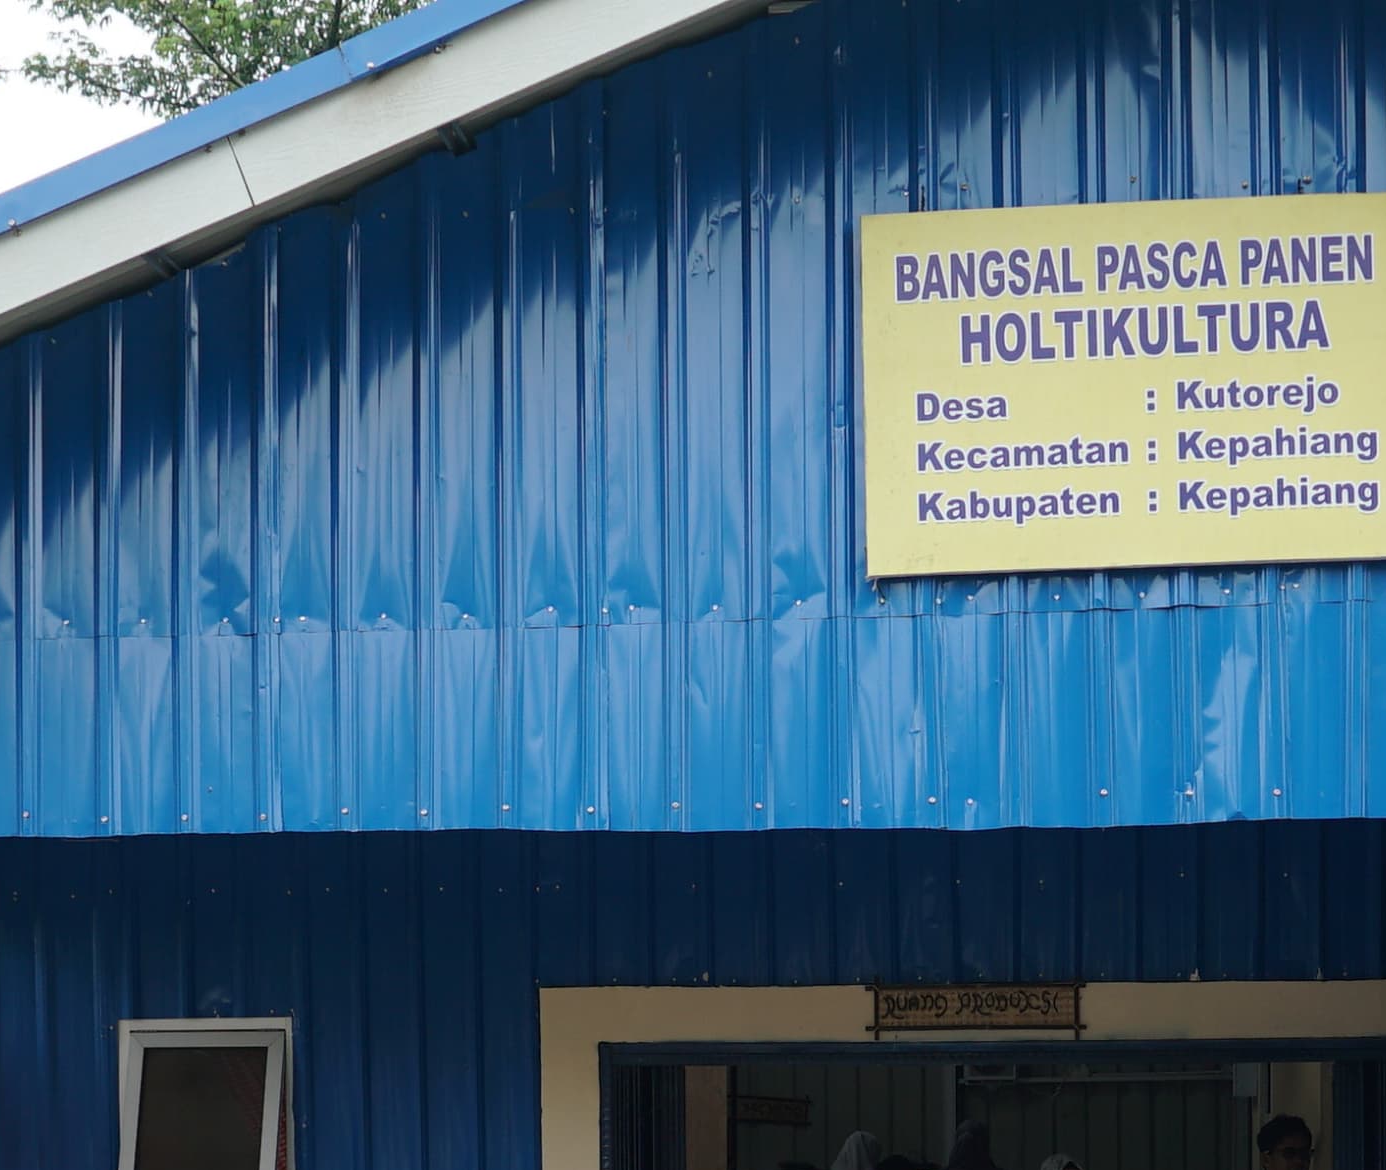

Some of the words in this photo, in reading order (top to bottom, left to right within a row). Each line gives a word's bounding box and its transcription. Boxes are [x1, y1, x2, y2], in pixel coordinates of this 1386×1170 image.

[894, 247, 1083, 301] BANGSAL
[1096, 240, 1227, 291] PASCA
[1241, 234, 1373, 286] PANEN
[960, 300, 1330, 365] HOLTIKULTURA
[916, 392, 1008, 421] Desa
[1177, 377, 1339, 412] Kutorejo
[917, 437, 1129, 471] Kecamatan
[1178, 429, 1378, 465] Kepahiang
[918, 487, 1120, 524] Kabupaten
[1178, 479, 1379, 515] Kepahiang
